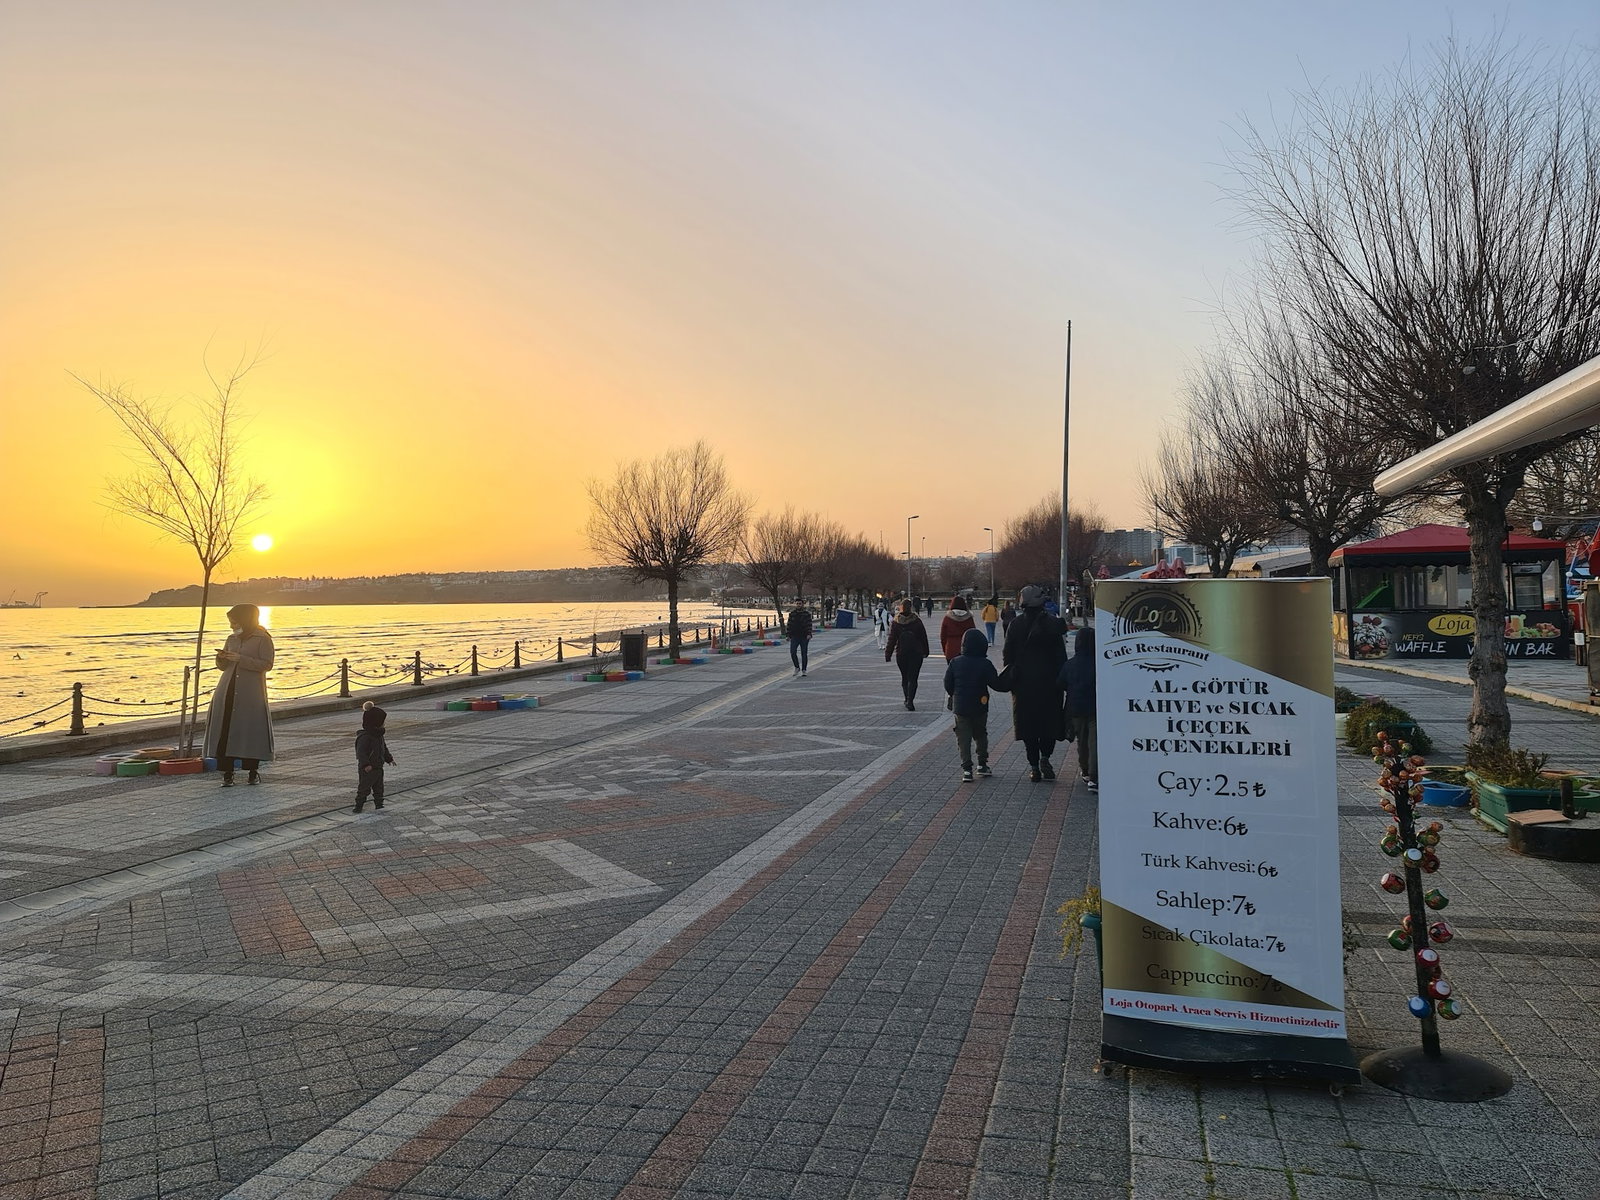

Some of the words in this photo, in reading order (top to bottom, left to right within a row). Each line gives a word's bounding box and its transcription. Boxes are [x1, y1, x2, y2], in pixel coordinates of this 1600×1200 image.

[1134, 605, 1178, 629] Loja
[1435, 617, 1472, 634] Loja
[1104, 646, 1132, 660] Cafe
[1136, 643, 1210, 661] Restaurant
[1395, 641, 1447, 653] WAFFLE
[1525, 642, 1556, 655] BAR
[1127, 699, 1201, 714] KAHVE
[1206, 704, 1224, 714] ve
[1229, 702, 1297, 716] SICAK
[1167, 717, 1251, 738] İÇEÇEK
[1132, 738, 1292, 757] SEÇENEKLERİ
[1141, 853, 1180, 869] Türk
[1142, 926, 1185, 942] Sıcak
[1109, 998, 1133, 1009] Loja
[1135, 1000, 1179, 1012] Otopark
[1181, 1005, 1211, 1016] Araca
[1214, 1008, 1247, 1020] Servis
[1250, 1011, 1340, 1029] Hizmetinizdedir
